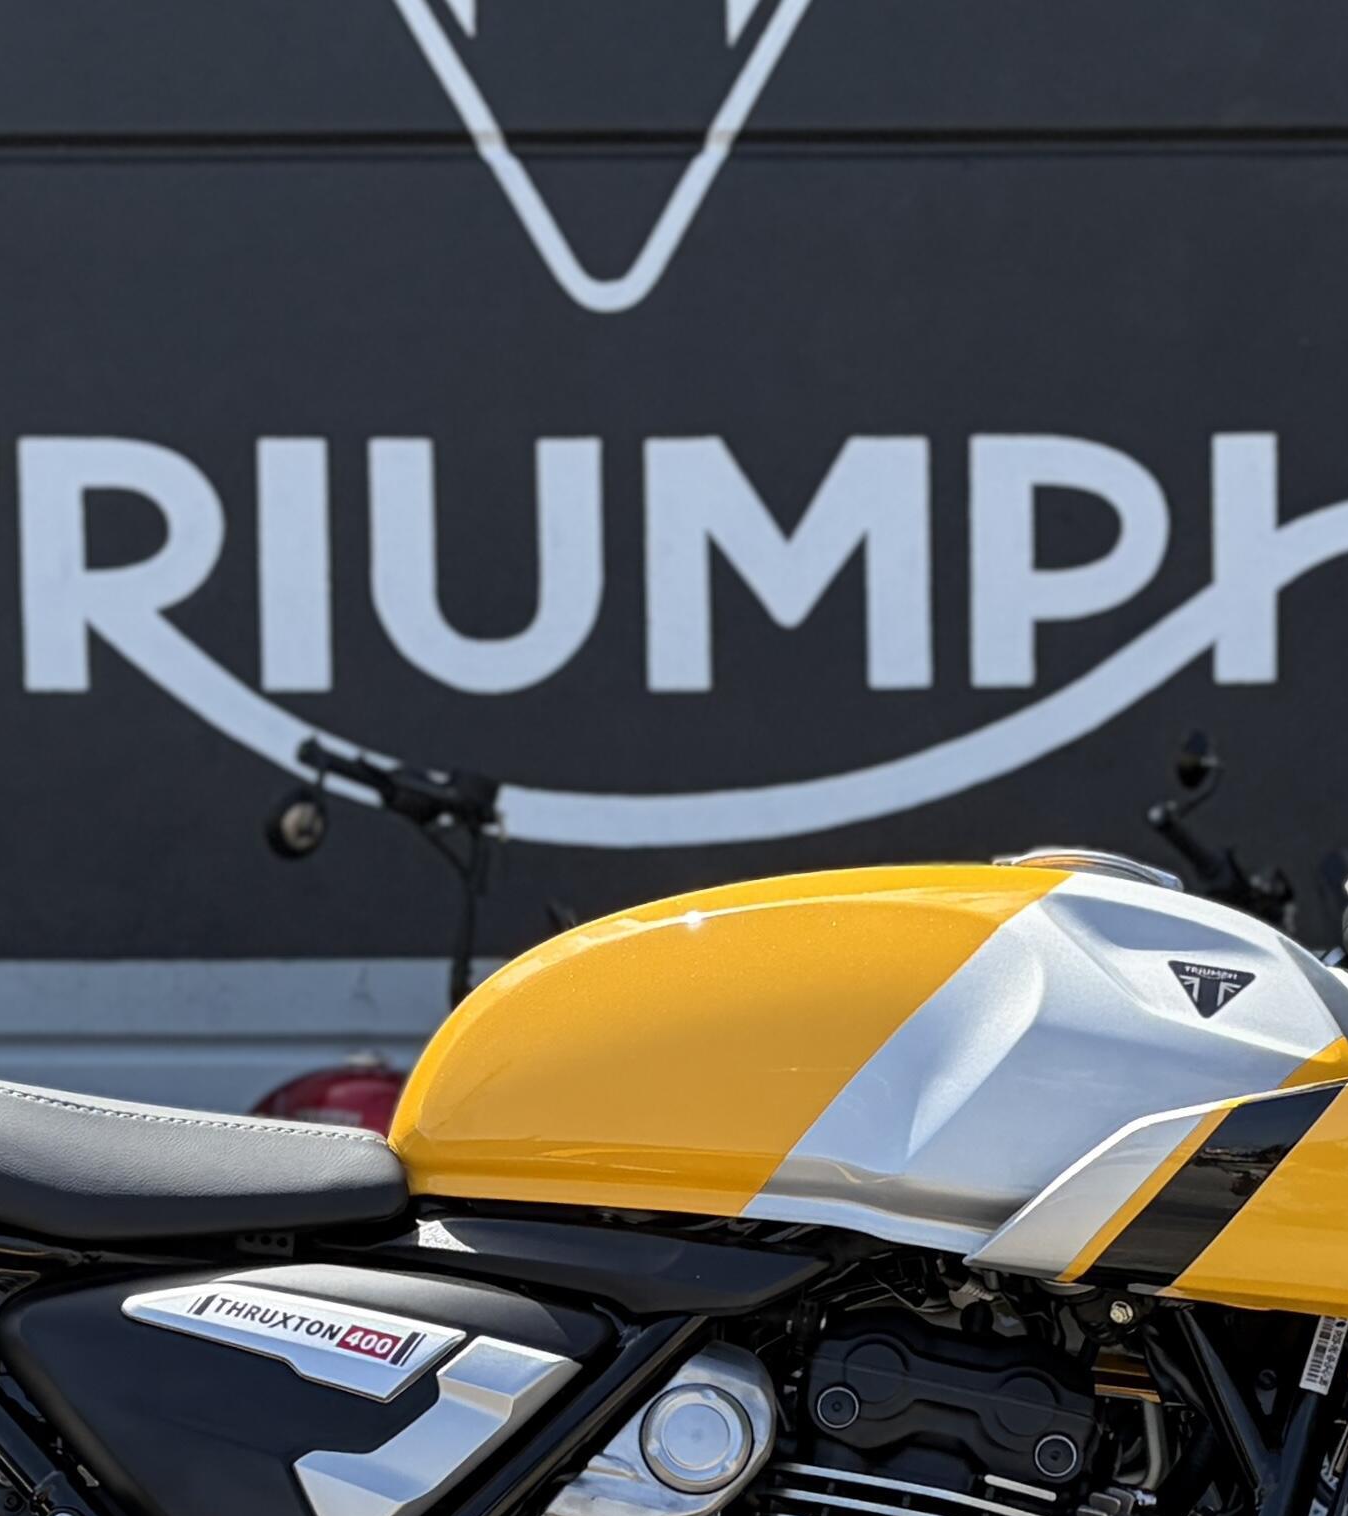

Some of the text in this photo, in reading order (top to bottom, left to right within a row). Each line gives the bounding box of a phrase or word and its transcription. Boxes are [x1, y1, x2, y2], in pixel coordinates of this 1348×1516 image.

[1184, 965, 1238, 981] TRIUMPH
[214, 1296, 393, 1355] THRUXTON 400
